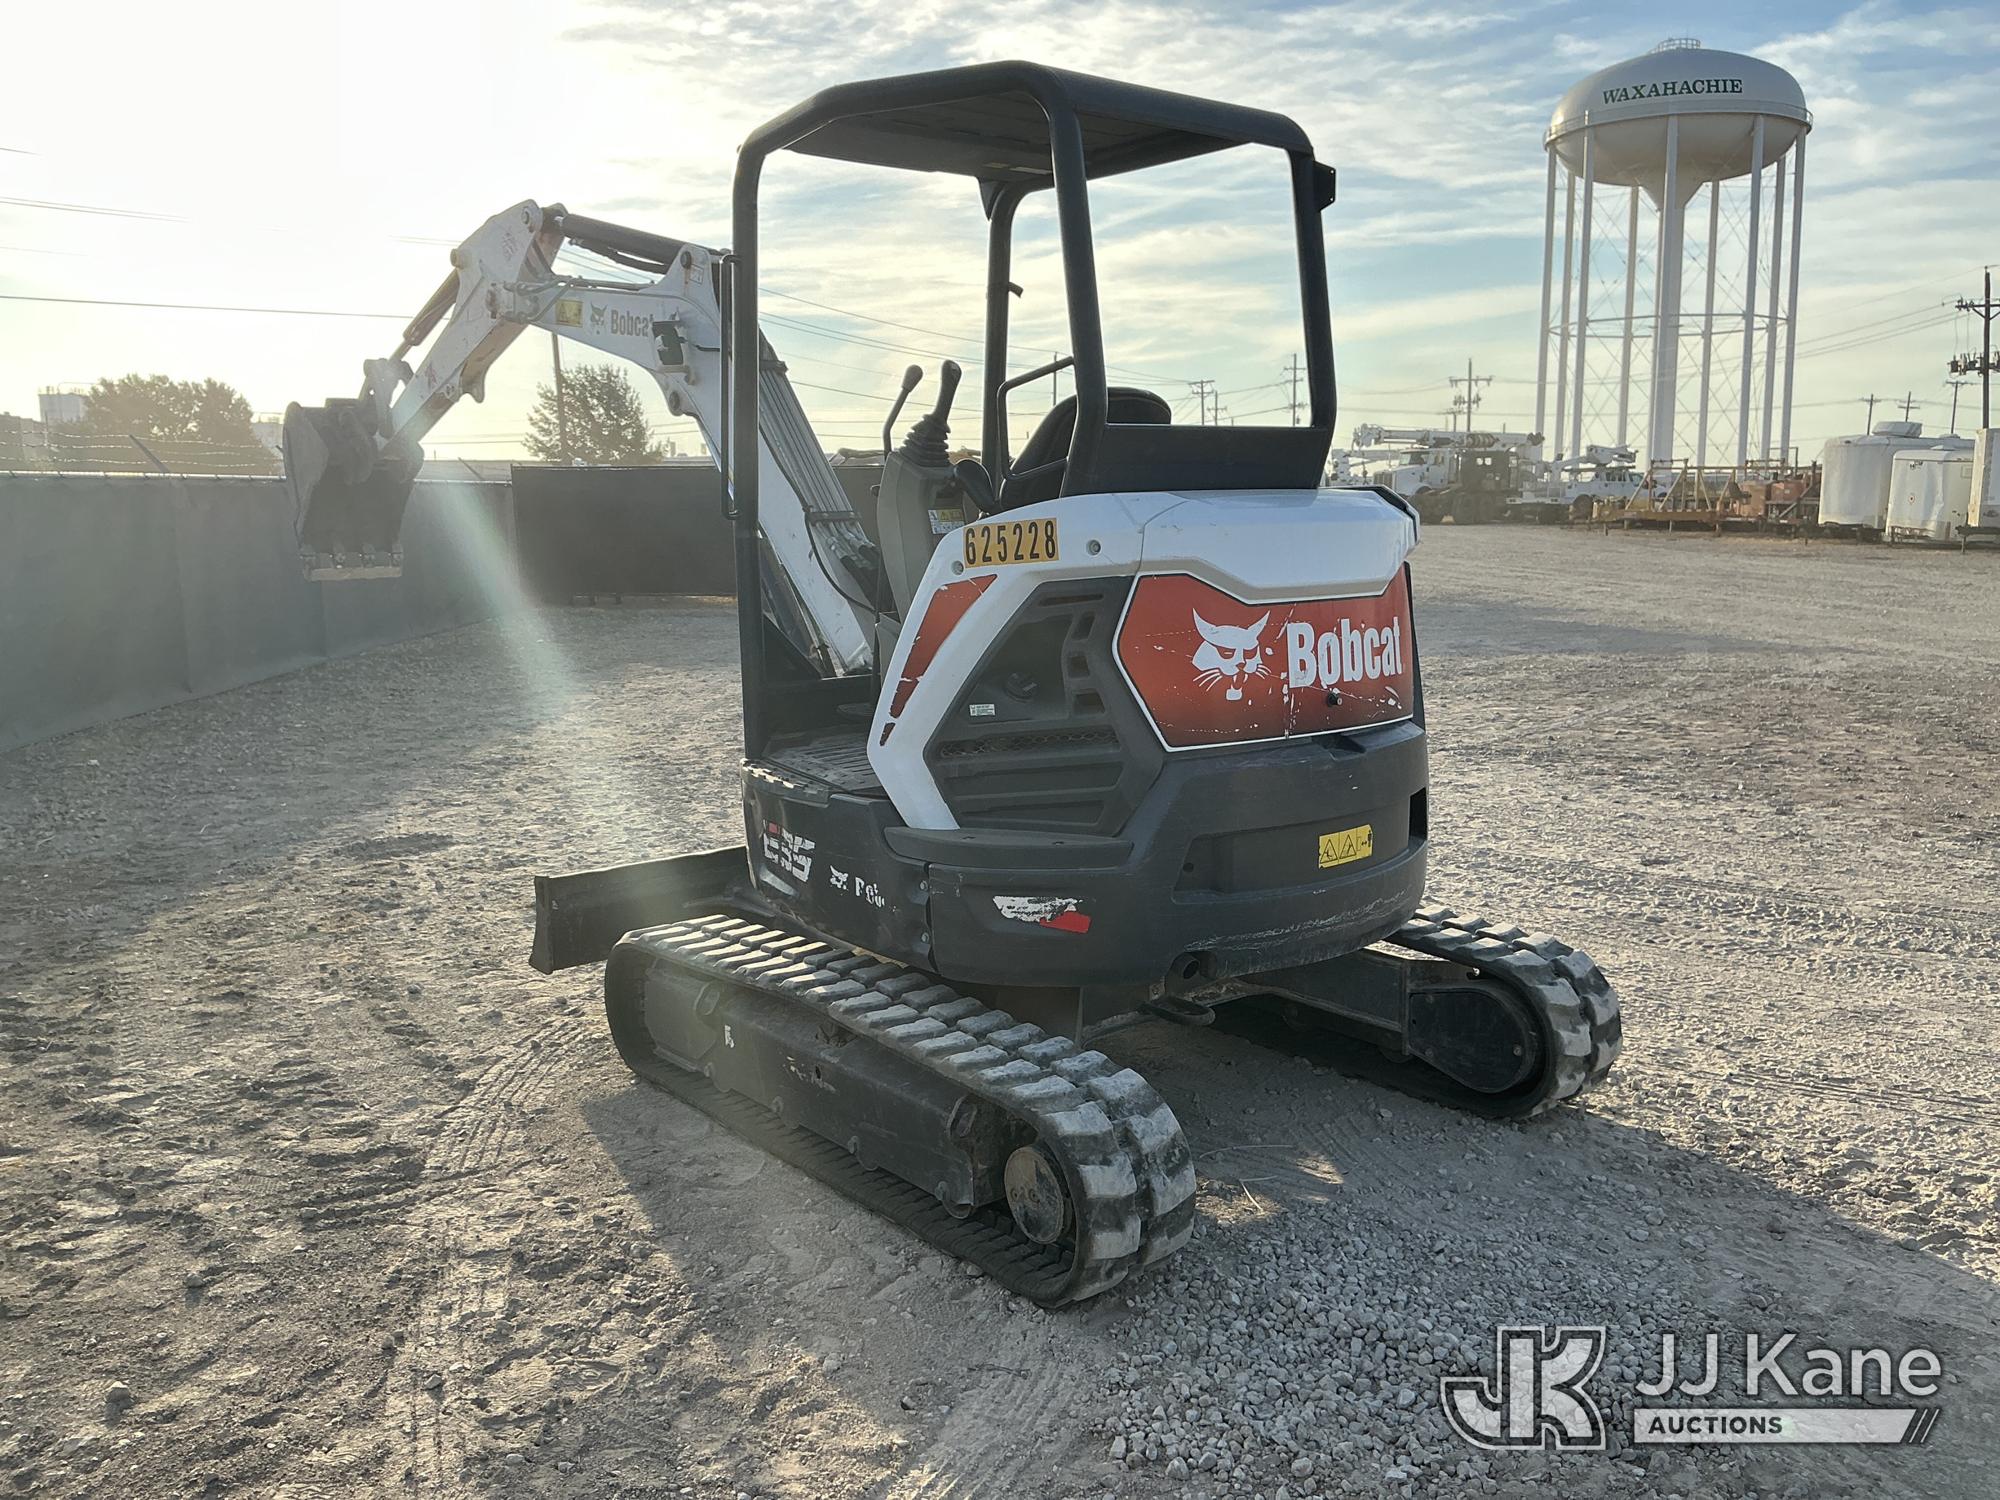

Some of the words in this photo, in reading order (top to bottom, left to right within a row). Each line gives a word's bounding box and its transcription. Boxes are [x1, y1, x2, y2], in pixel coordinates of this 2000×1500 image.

[1603, 79, 1743, 104] WAXAHACHIE
[965, 520, 1056, 565] 625228
[1286, 616, 1402, 689] Bobcat
